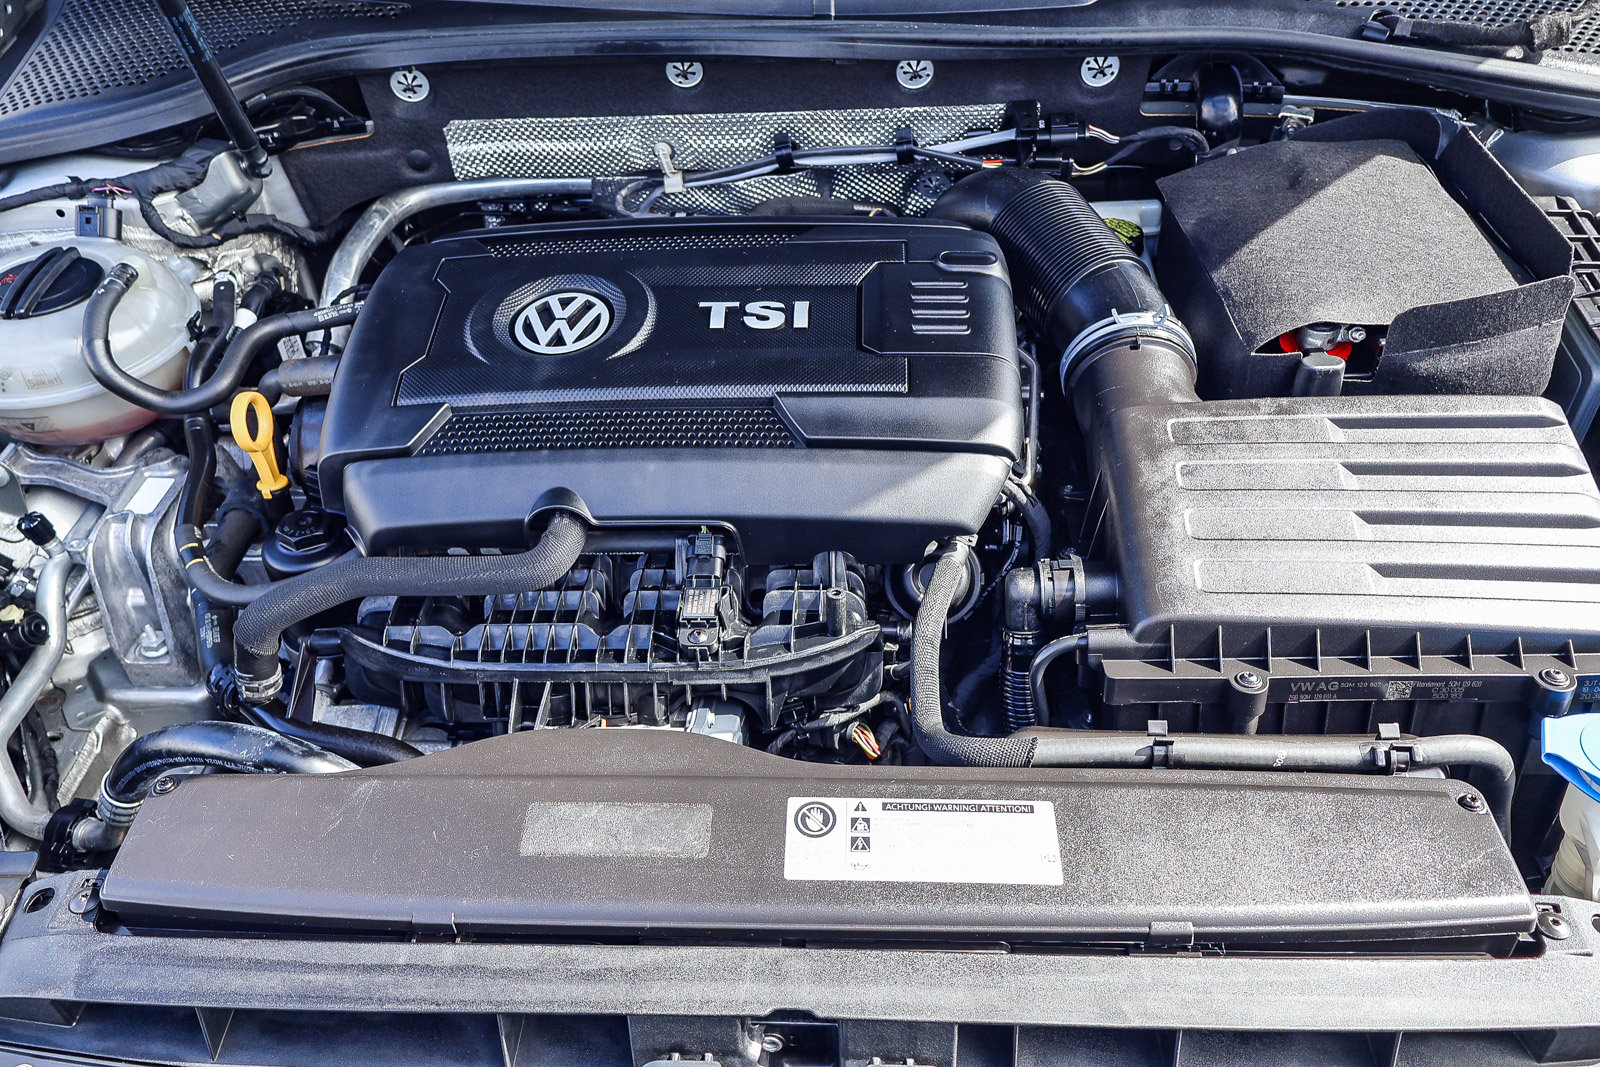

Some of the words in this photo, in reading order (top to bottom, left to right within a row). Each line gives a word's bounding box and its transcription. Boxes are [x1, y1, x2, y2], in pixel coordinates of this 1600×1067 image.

[514, 292, 610, 355] VW
[698, 301, 810, 329] TSI
[885, 802, 931, 812] ACHTUNG!
[934, 803, 979, 812] WARNING!
[980, 804, 1031, 814] ATTENTION!
